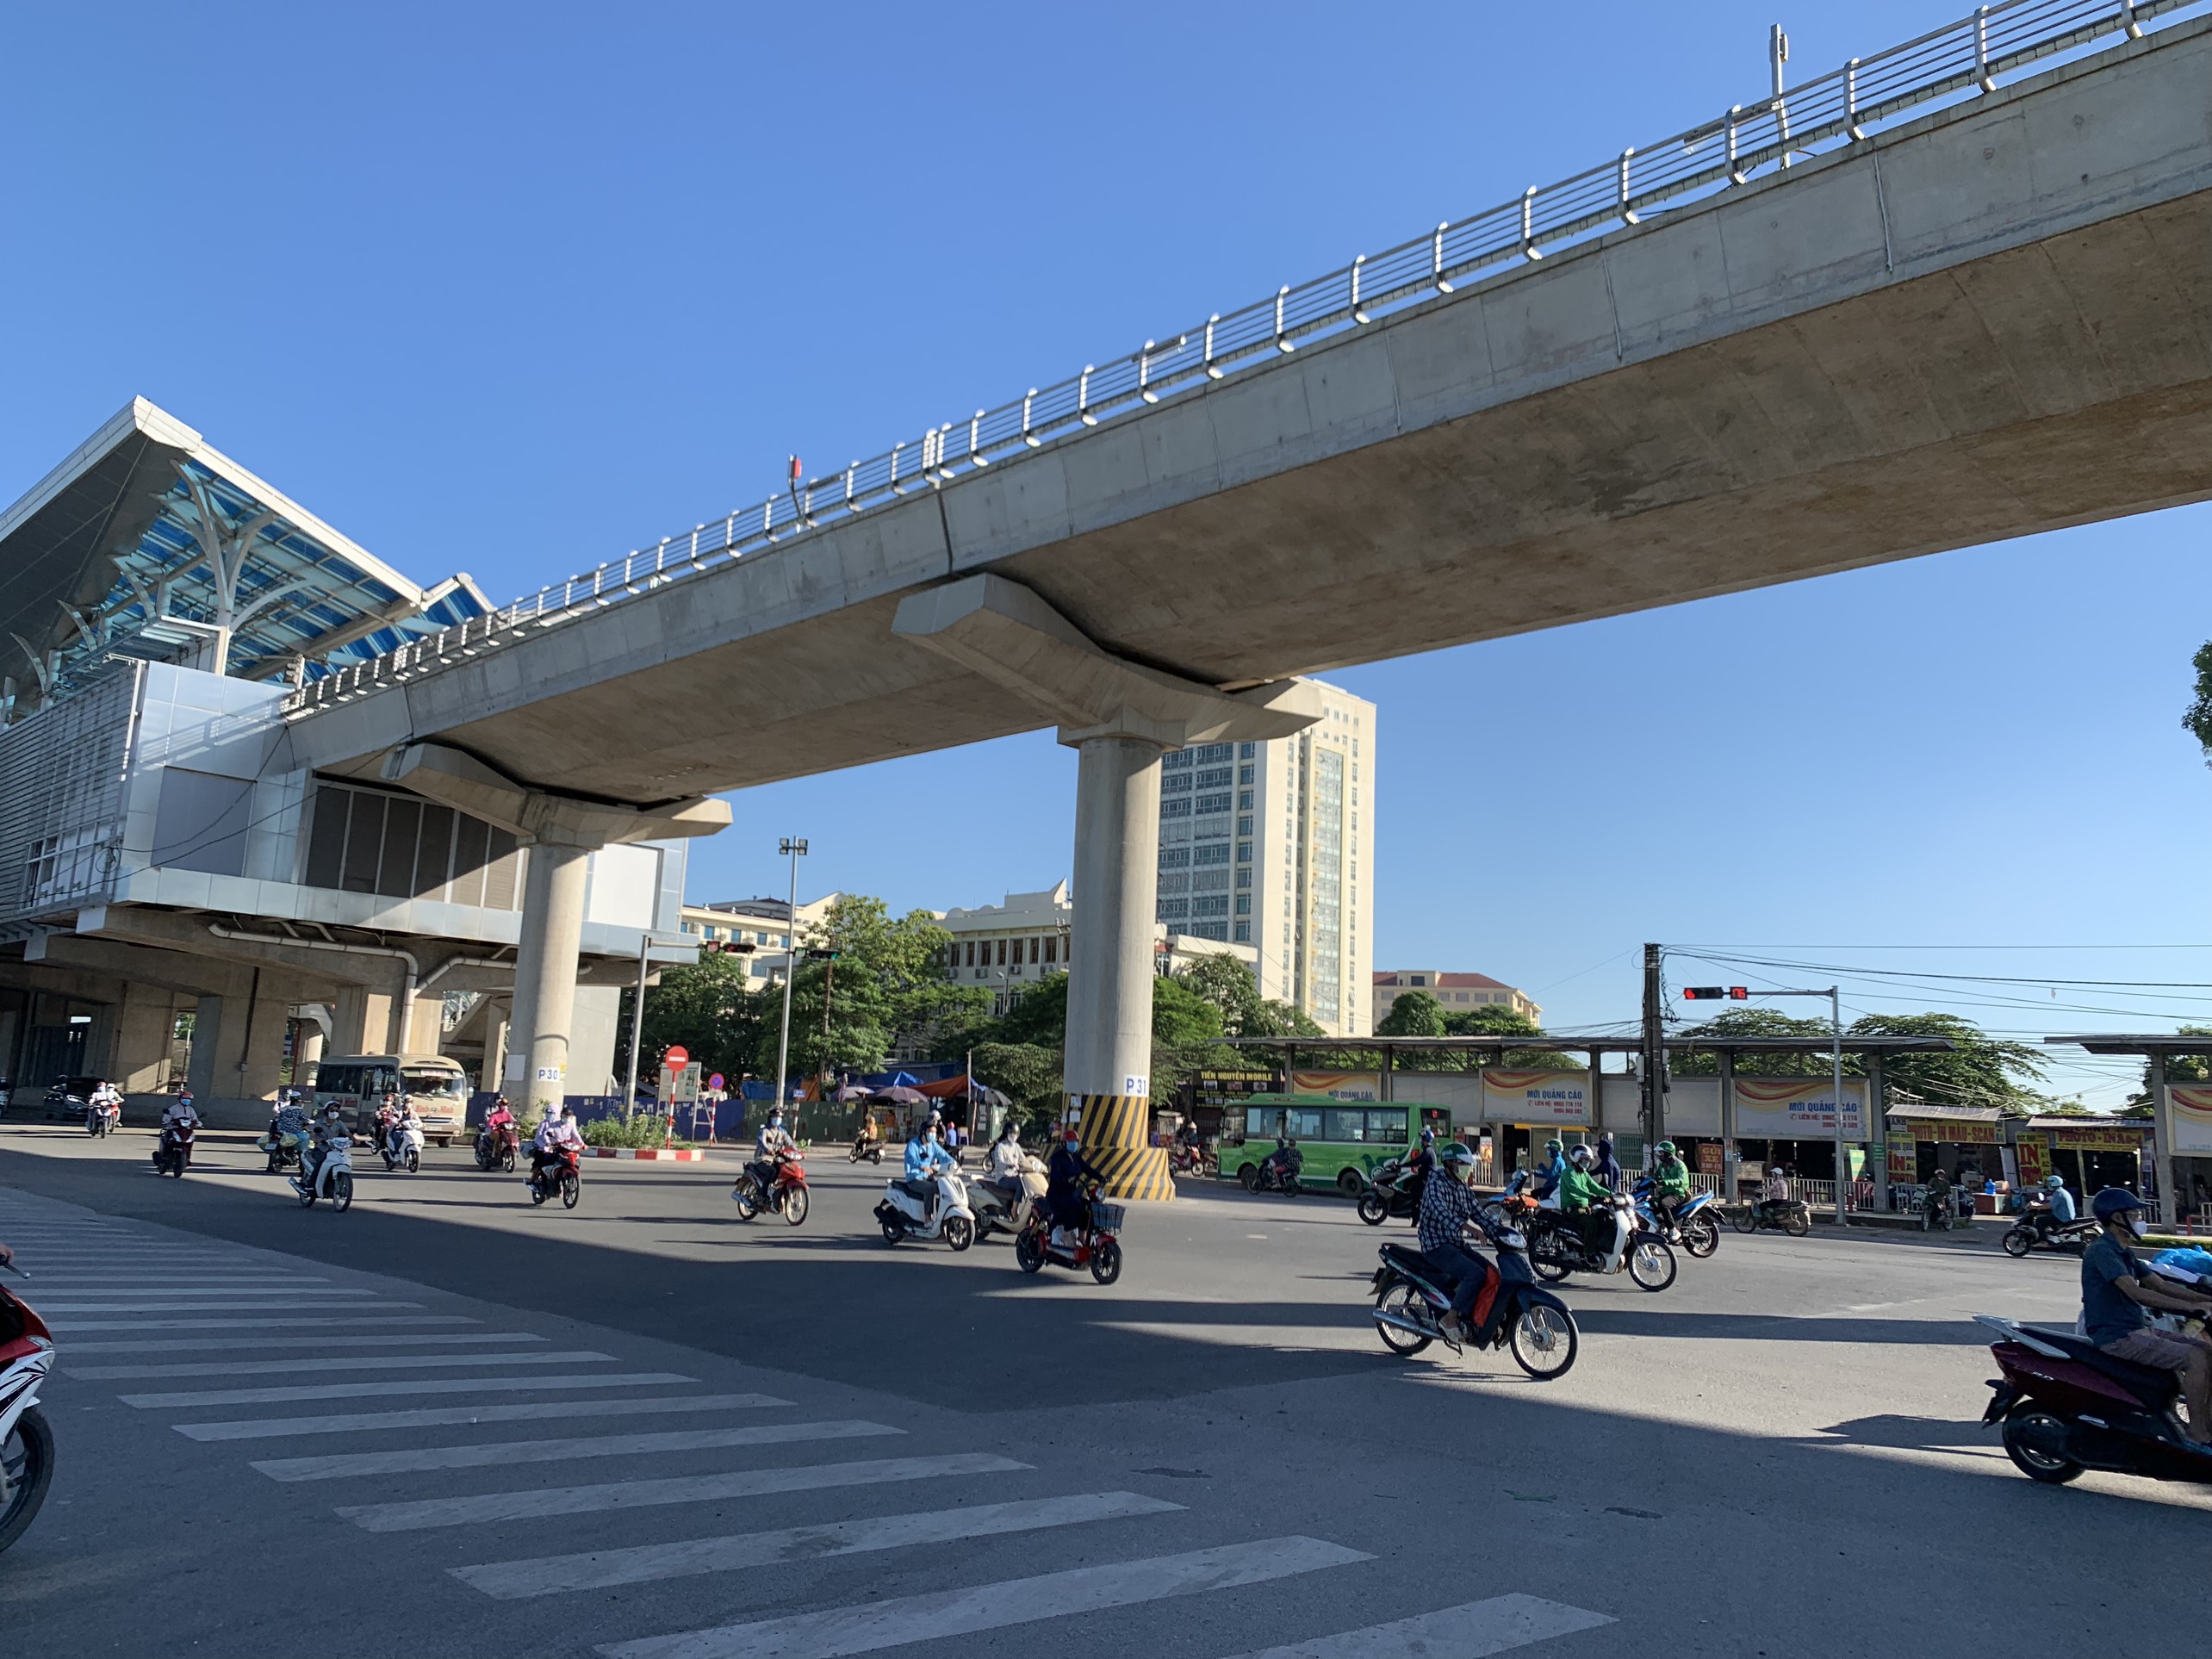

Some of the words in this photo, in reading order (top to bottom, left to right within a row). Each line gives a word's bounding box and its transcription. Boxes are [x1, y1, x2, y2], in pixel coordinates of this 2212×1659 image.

[538, 1070, 545, 1079] P
[547, 1070, 558, 1079] 30
[1246, 1072, 1273, 1081] MOBILE
[1127, 1078, 1134, 1093] P
[1137, 1078, 1146, 1094] 31
[1340, 1089, 1360, 1099] QUẢNG
[1542, 1088, 1566, 1099] QUẢNG
[1568, 1090, 1582, 1099] CÁO
[1937, 1125, 1947, 1140] IN
[1948, 1122, 1967, 1141] MÀU
[1972, 1127, 1996, 1142] SCAN
[2058, 1131, 2096, 1143] PHOTO
[2019, 1144, 2039, 1165] IN
